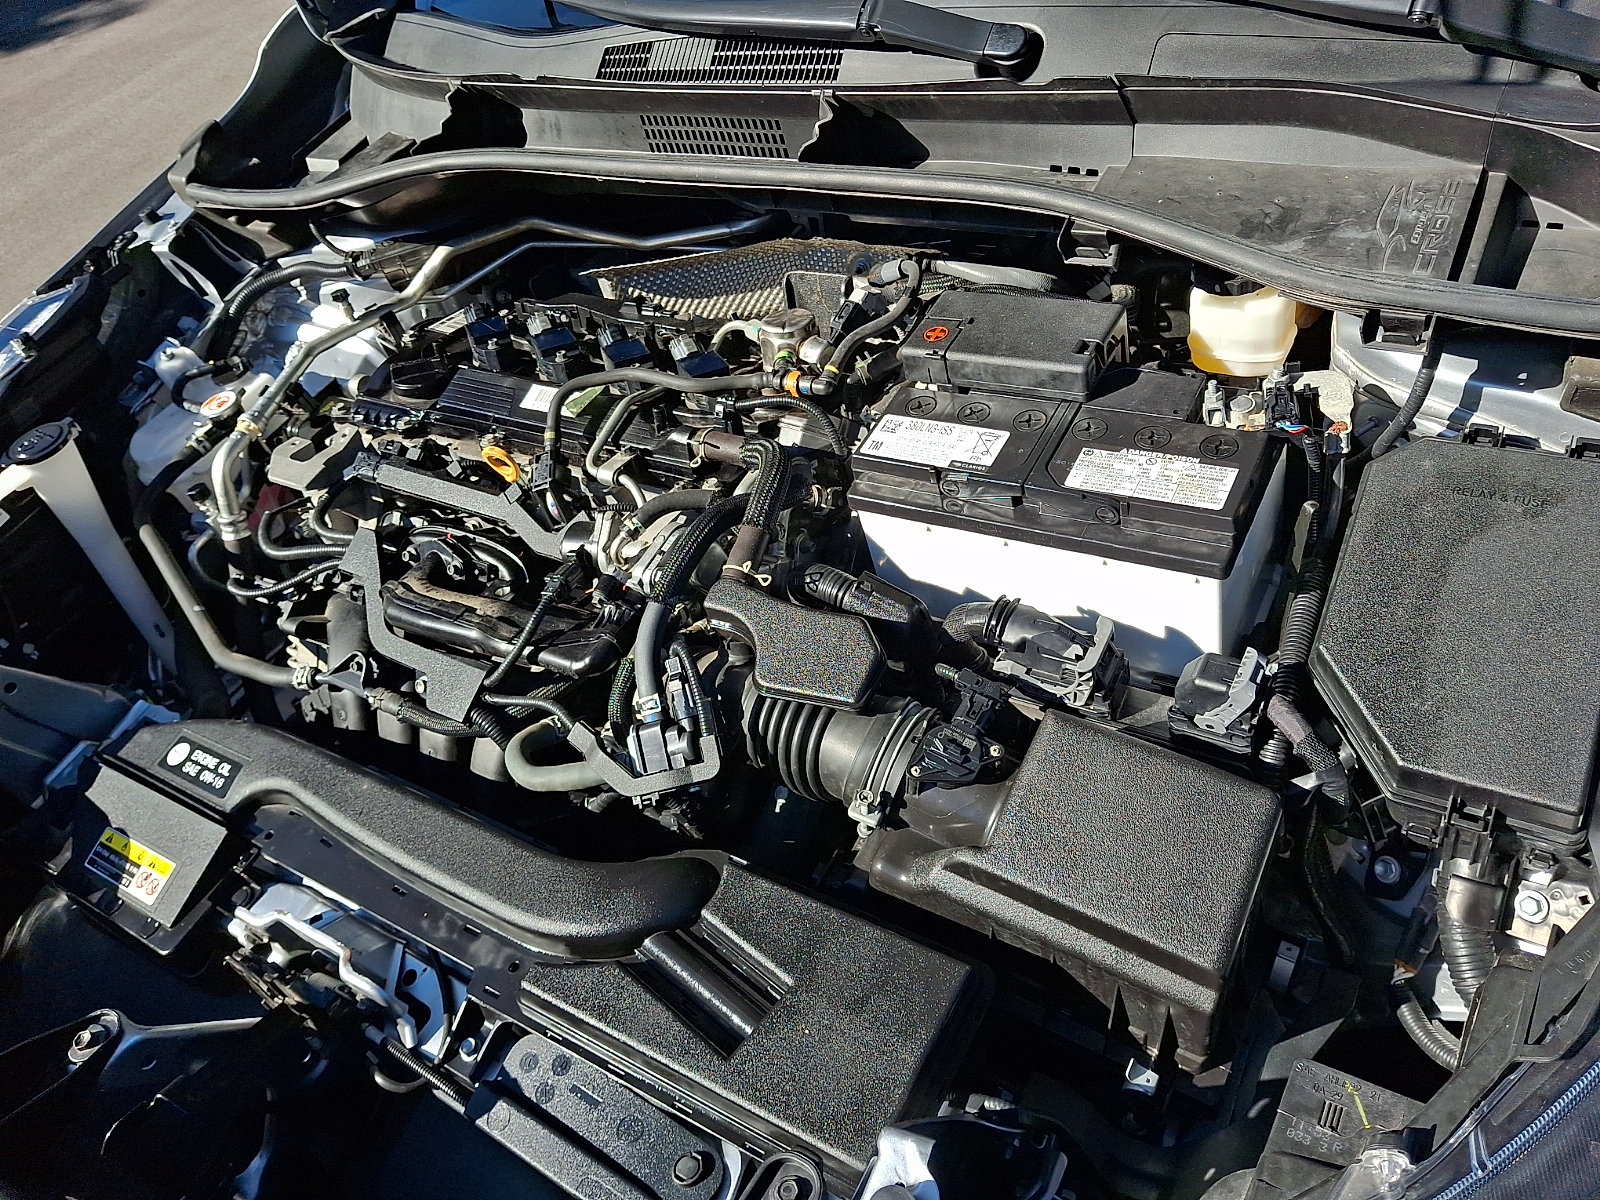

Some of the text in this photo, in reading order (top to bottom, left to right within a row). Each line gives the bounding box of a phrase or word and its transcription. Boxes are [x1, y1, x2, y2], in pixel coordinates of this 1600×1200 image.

[1413, 178, 1462, 275] CROSS
[868, 440, 884, 451] TM
[1452, 486, 1551, 509] RELAY & FUSE
[181, 761, 201, 777] SAE
[1295, 1062, 1317, 1077] SAE
